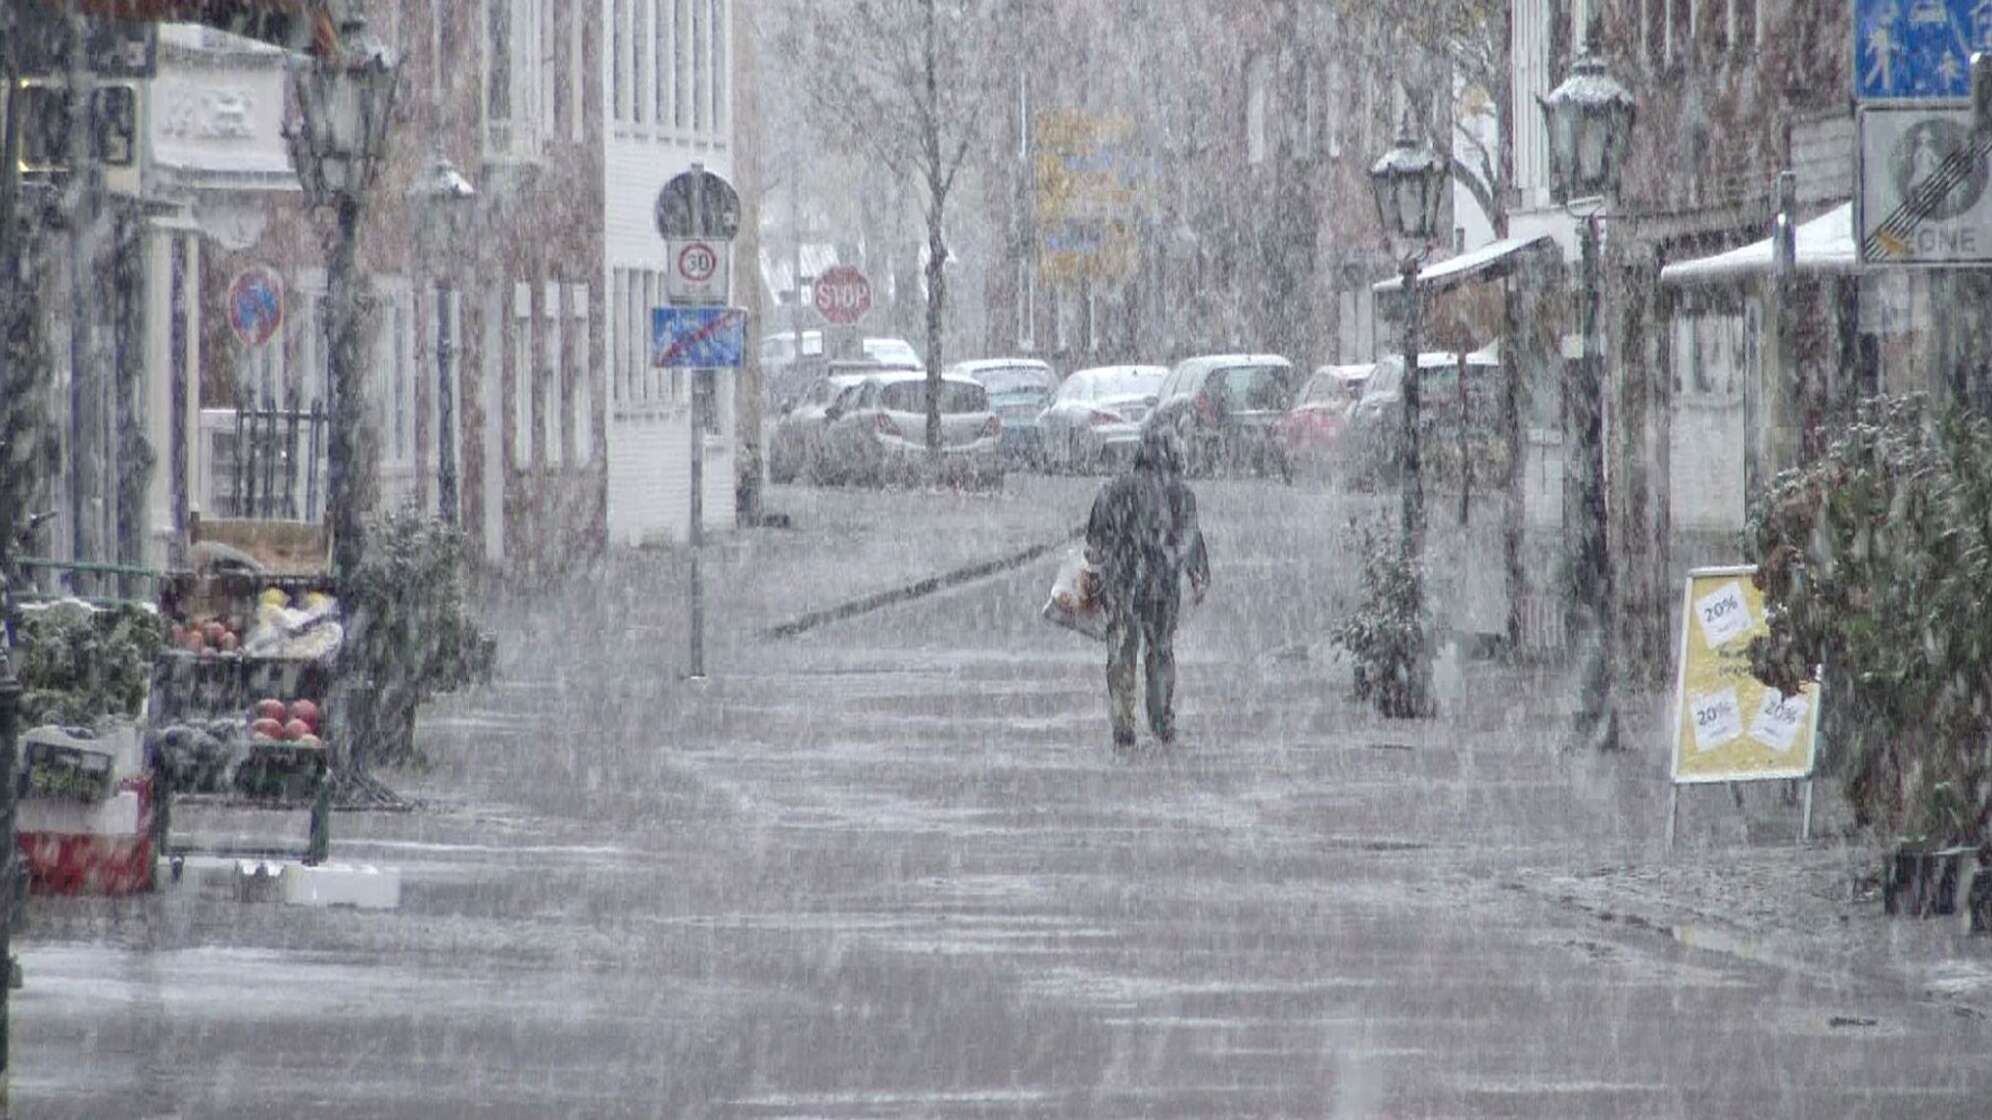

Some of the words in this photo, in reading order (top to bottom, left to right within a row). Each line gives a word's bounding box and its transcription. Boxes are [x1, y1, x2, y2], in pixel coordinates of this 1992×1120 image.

[687, 252, 709, 272] 30
[818, 283, 868, 310] STOP
[1704, 593, 1738, 622] 20%
